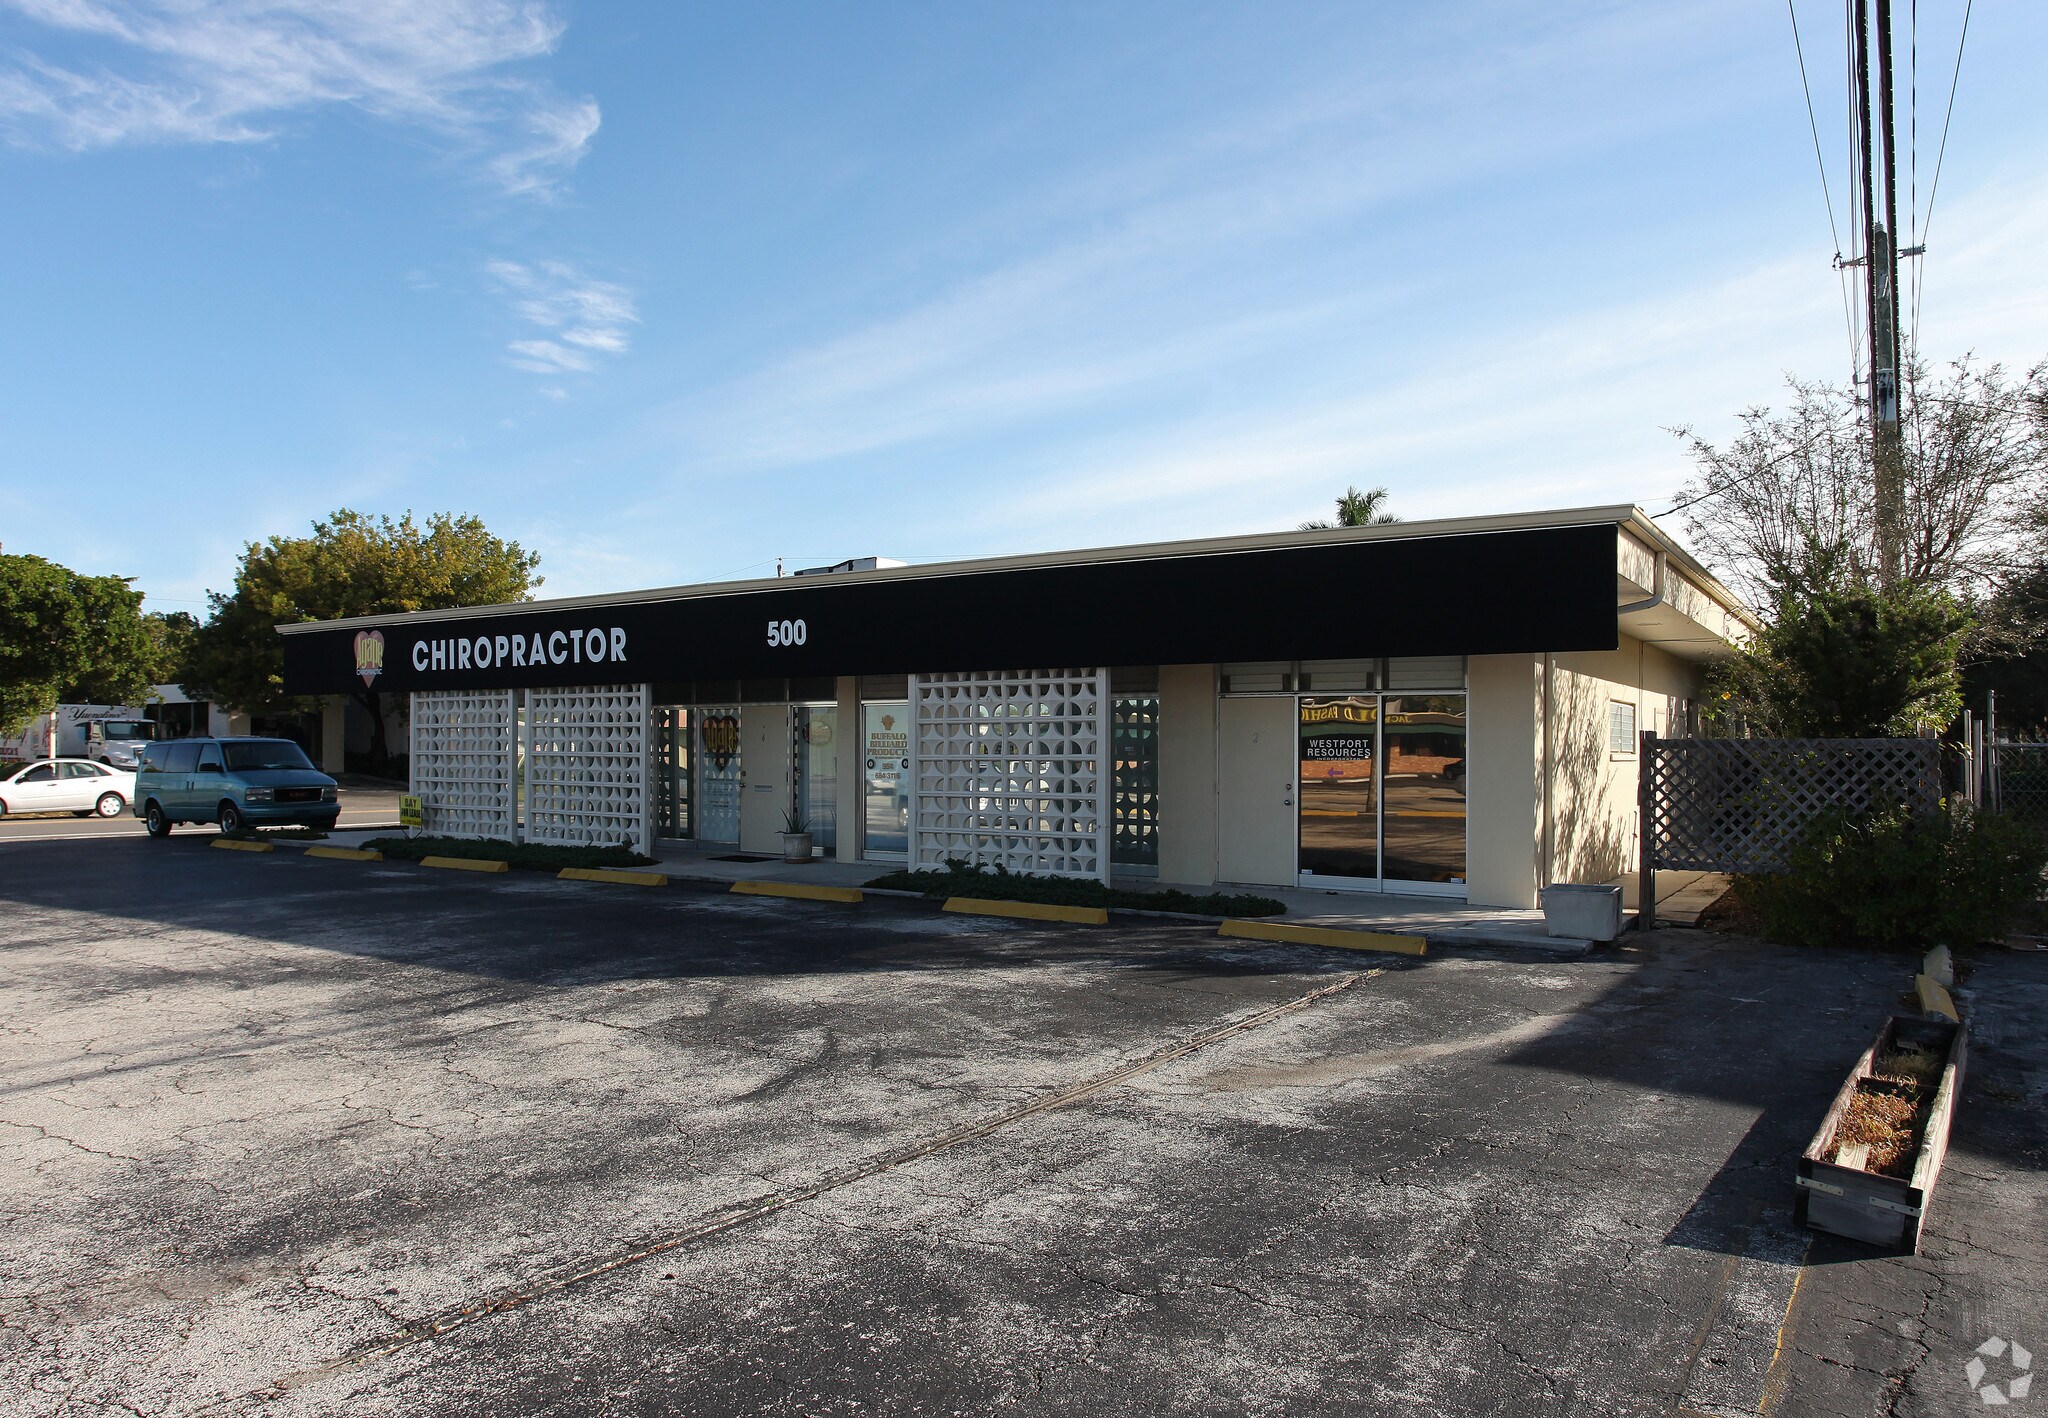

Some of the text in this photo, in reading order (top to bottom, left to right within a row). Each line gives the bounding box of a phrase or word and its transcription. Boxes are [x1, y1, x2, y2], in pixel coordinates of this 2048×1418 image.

[767, 619, 807, 647] 500
[412, 627, 628, 672] CHIROPRACTOR
[1309, 740, 1369, 748] WESTPORT
[1307, 749, 1371, 758] RESOURCES
